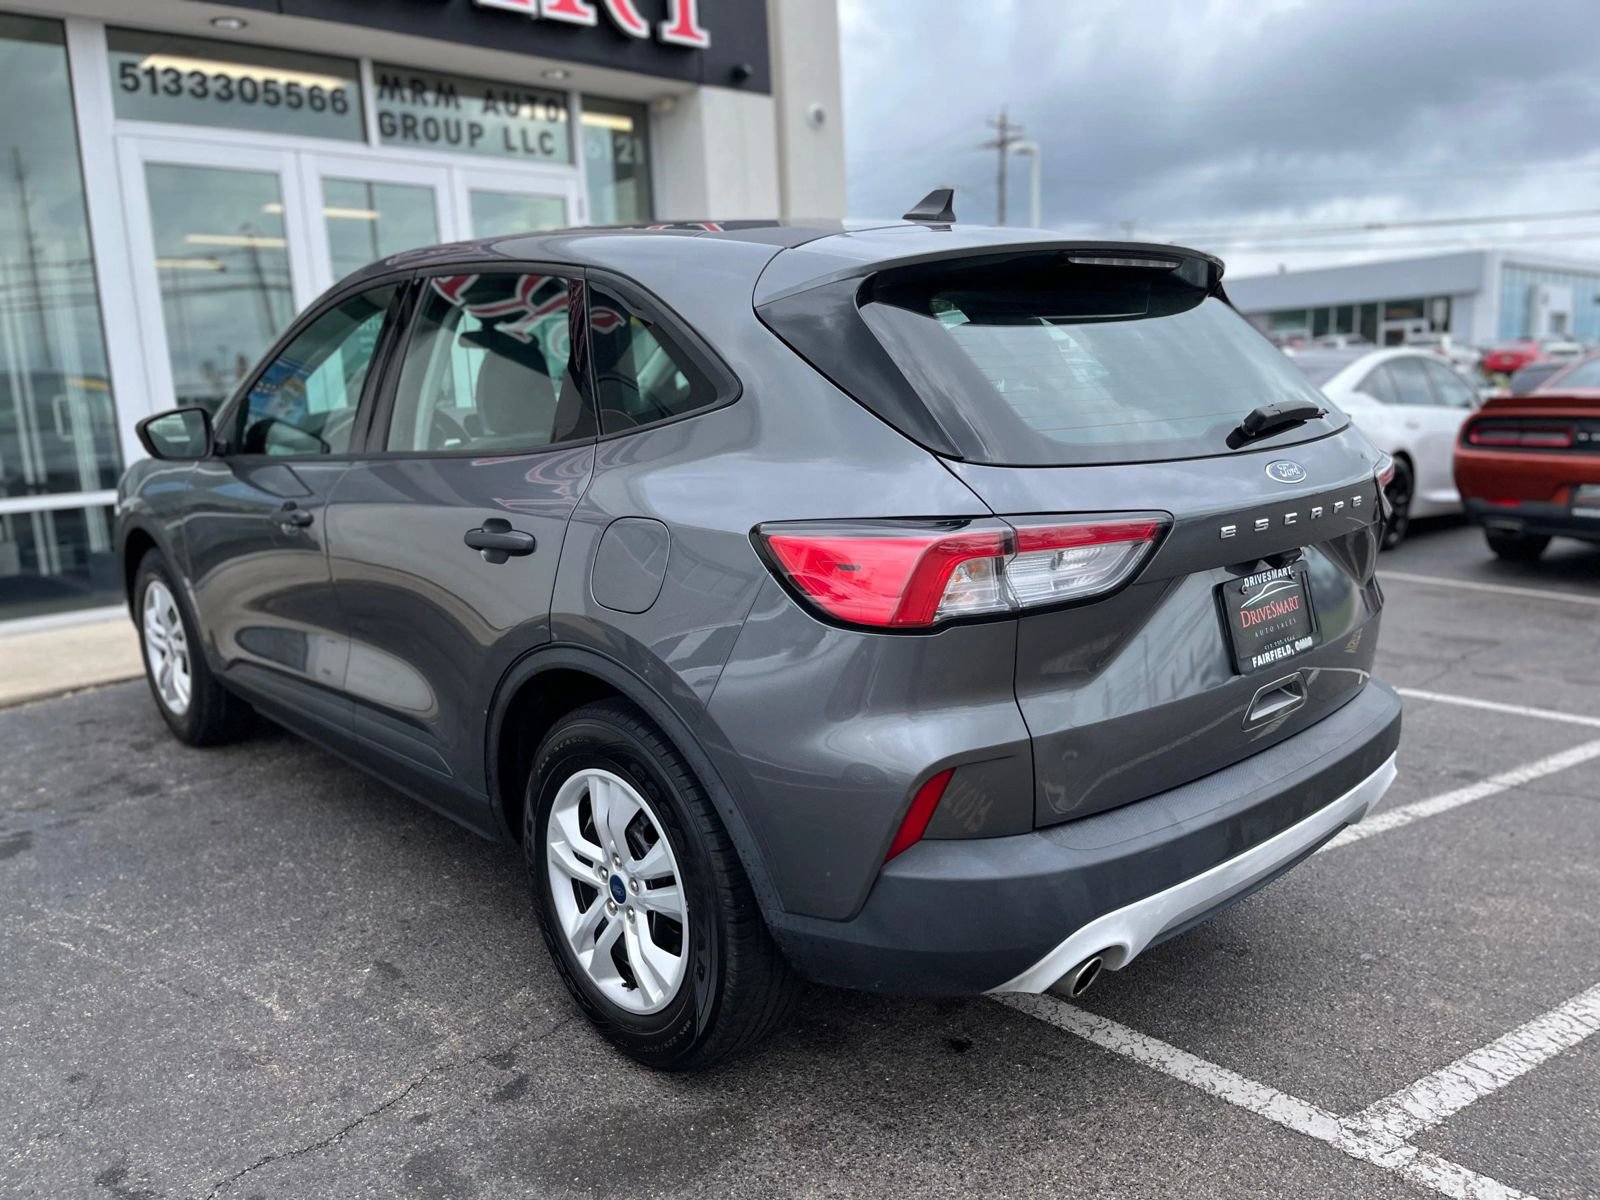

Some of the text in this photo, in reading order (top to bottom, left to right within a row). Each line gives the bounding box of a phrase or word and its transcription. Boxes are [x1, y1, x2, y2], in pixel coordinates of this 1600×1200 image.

[118, 61, 349, 115] 5133305566
[377, 74, 563, 122] MRM AUTO
[378, 111, 556, 156] GROUP LLC
[1220, 495, 1362, 539] ESCAPE
[1243, 566, 1293, 588] DRIVESMART
[1255, 625, 1274, 638] AUTO
[1251, 644, 1295, 668] FAIRFIELD,
